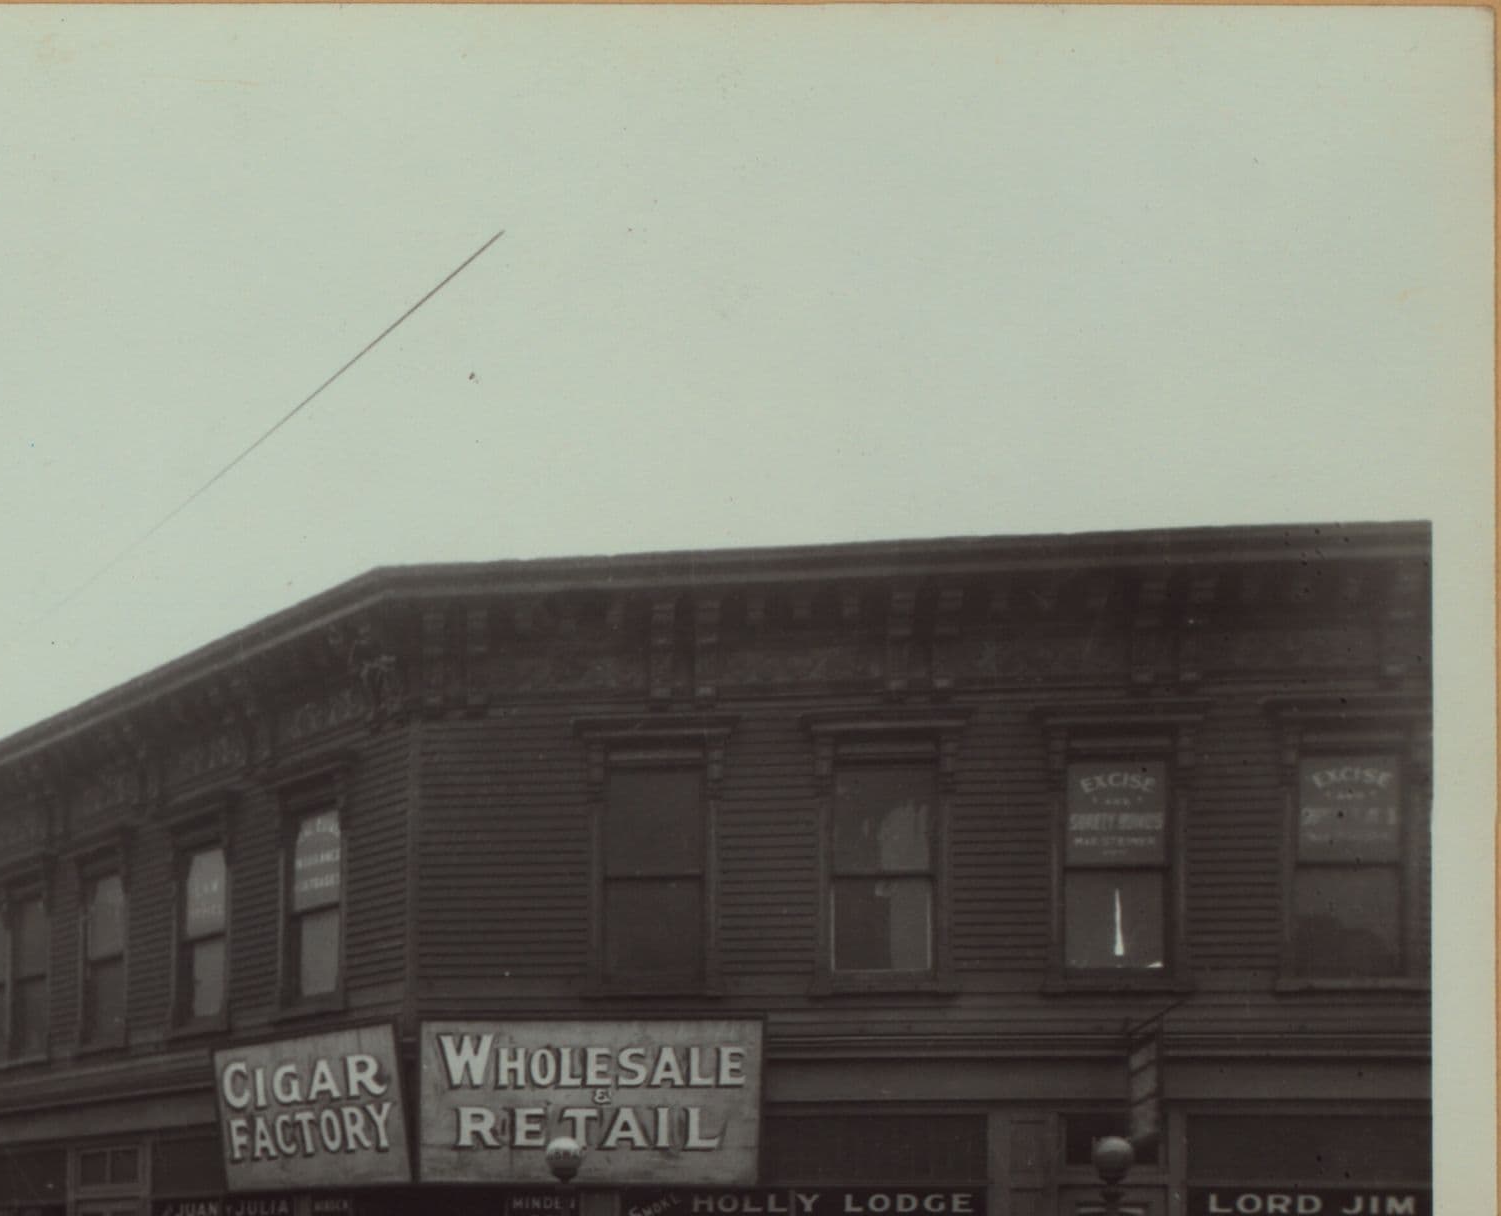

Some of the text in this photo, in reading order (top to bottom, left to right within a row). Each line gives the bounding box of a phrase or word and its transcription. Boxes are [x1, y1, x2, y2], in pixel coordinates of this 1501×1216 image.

[1080, 771, 1156, 794] EXCISE
[1312, 766, 1395, 789] EXCISE
[439, 1033, 747, 1089] WHOLESALE
[222, 1053, 389, 1110] CIGAR
[593, 1089, 612, 1104] &
[229, 1101, 393, 1163] FACTORY
[455, 1106, 728, 1151] RETAIL
[691, 1193, 974, 1213] HOLLY LODGE
[1208, 1193, 1415, 1216] LORD JIM
